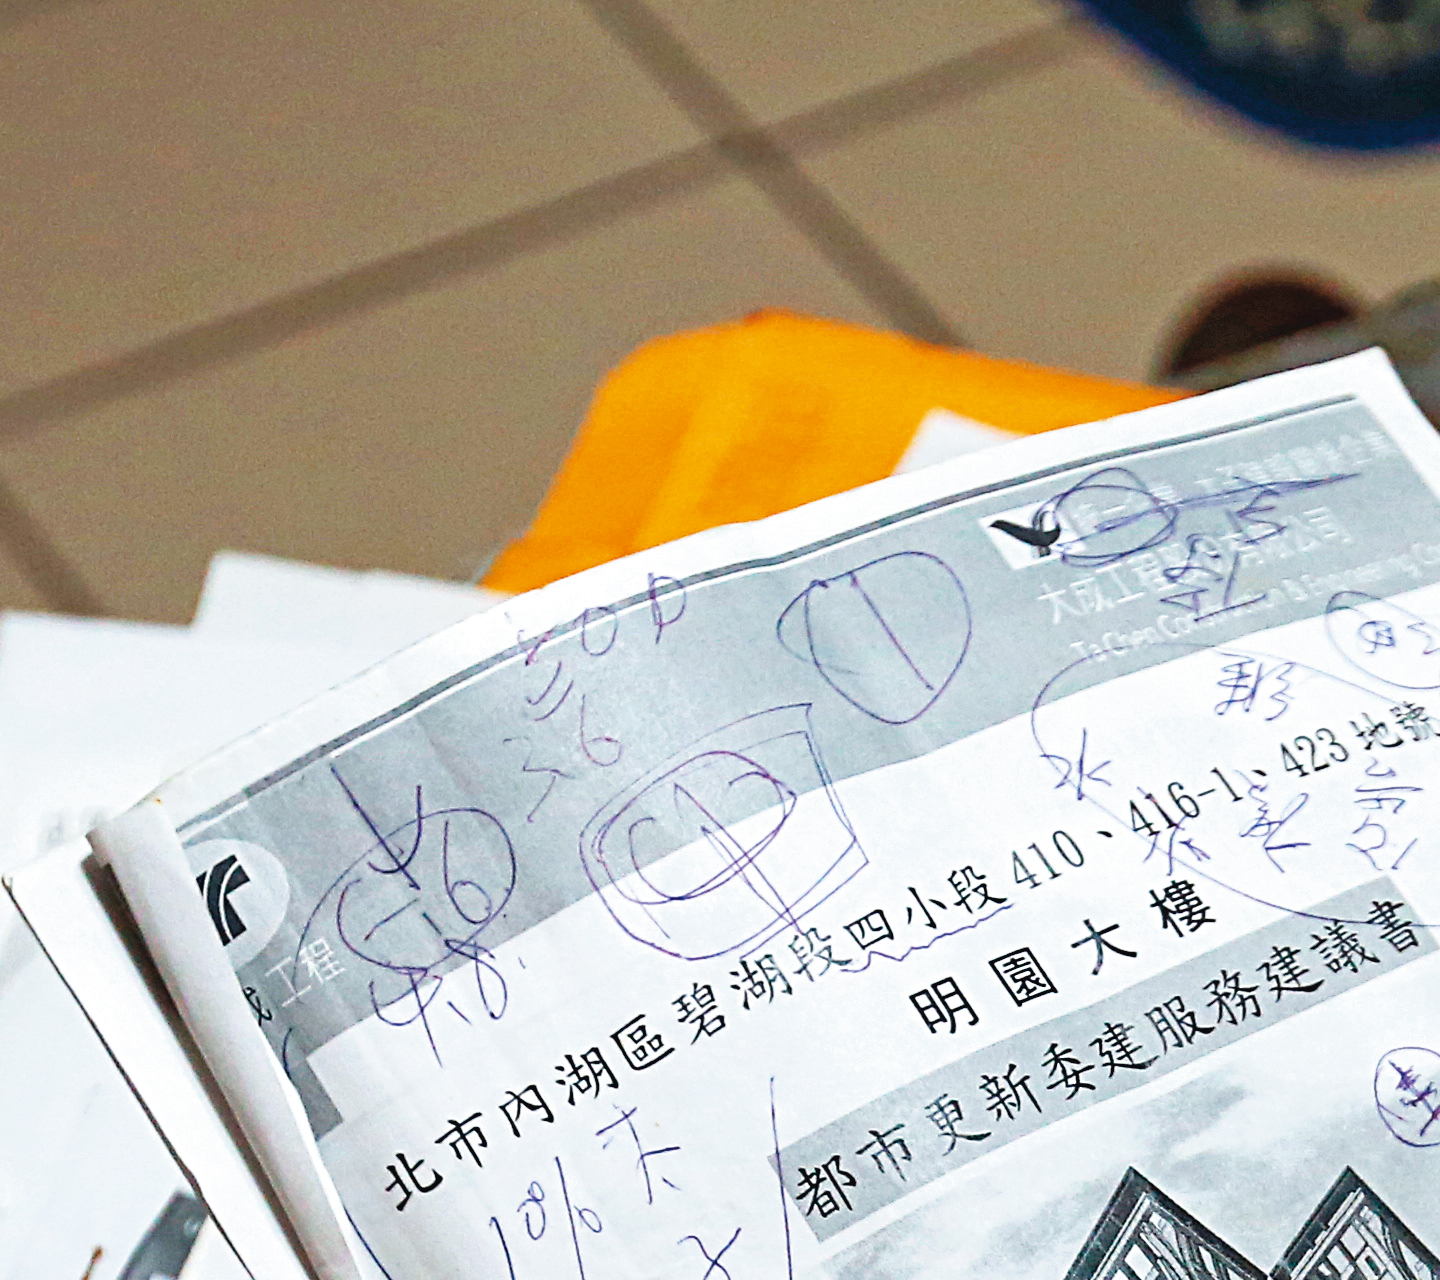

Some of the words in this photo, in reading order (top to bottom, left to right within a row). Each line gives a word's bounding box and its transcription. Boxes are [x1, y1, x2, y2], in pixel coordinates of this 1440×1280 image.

[796, 899, 1422, 1219] 都市更新委建服務建議書
[910, 878, 1216, 1036] 明園大樓
